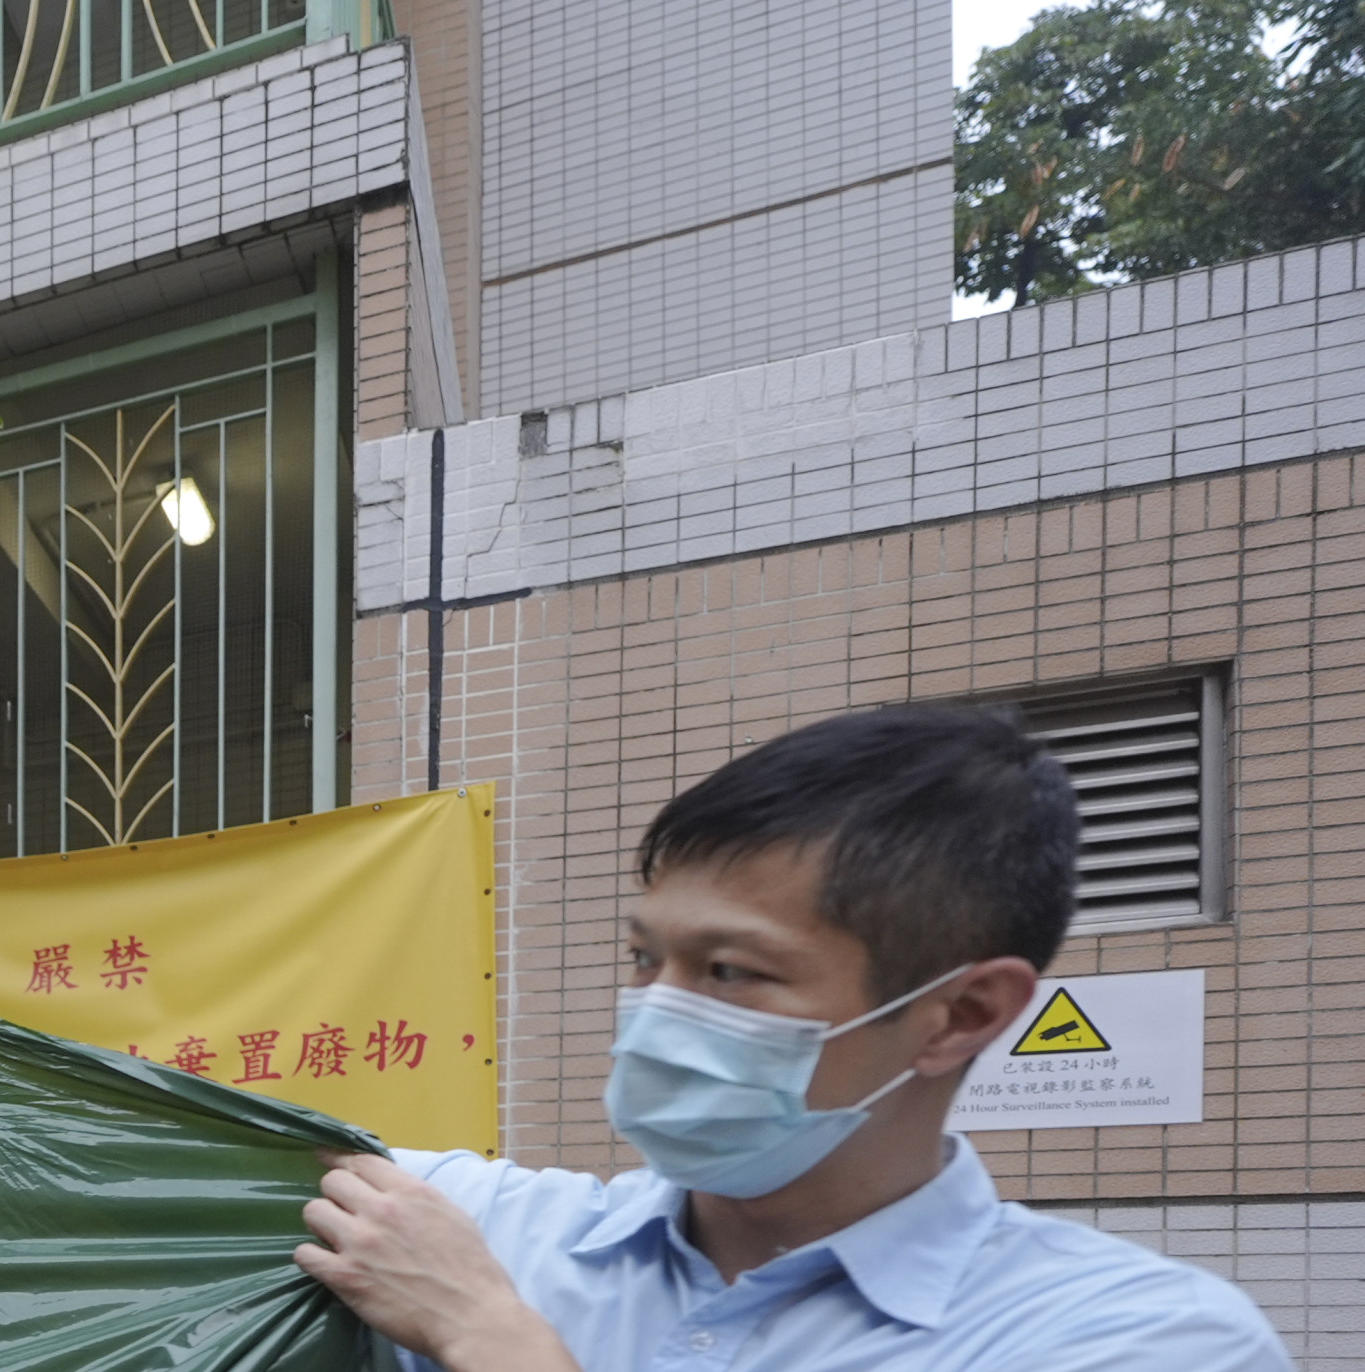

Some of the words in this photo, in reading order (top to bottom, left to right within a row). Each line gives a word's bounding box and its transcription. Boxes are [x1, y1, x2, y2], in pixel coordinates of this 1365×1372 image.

[25, 935, 151, 994] 嚴禁
[128, 1020, 475, 1084] 棄置廢物，
[971, 1103, 998, 1113] Hour
[1002, 1100, 1071, 1112] Surveillance
[1075, 1099, 1116, 1111] System
[1120, 1096, 1170, 1107] installed
